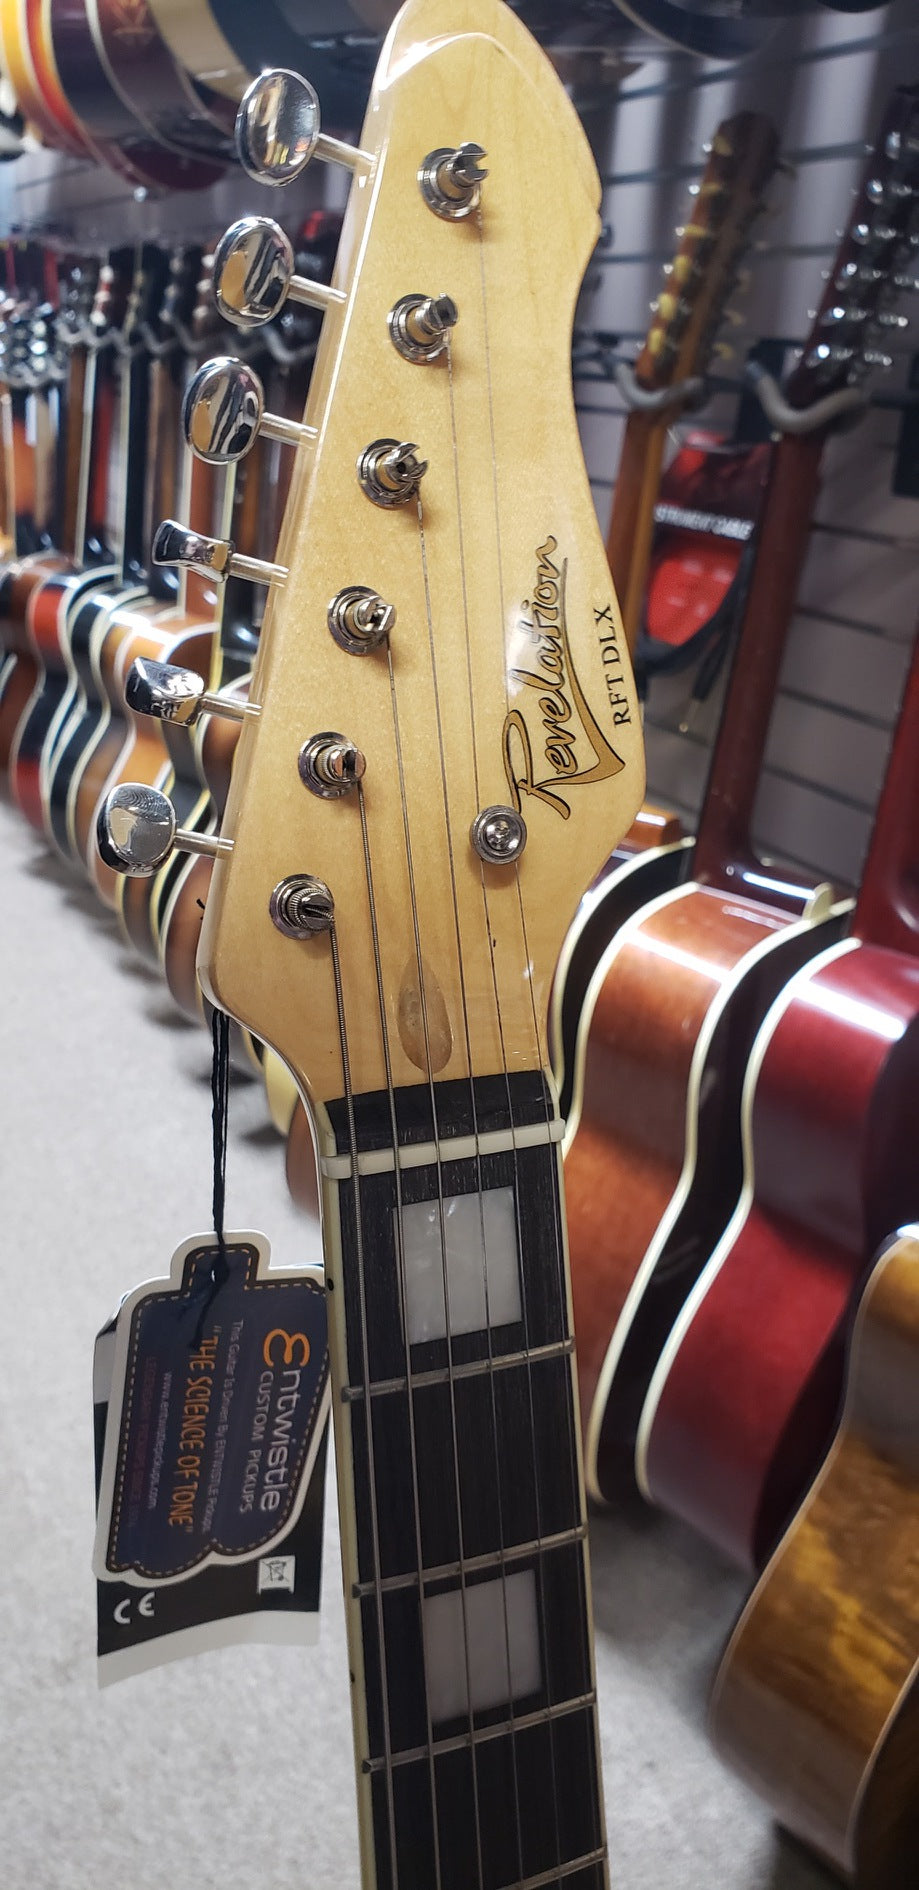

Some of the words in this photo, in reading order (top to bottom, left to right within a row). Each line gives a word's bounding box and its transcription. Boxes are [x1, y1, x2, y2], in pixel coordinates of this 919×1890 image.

[593, 603, 622, 665] DLX
[502, 535, 590, 820] Revelation
[605, 674, 632, 728] RFT
[230, 1319, 244, 1342] This
[226, 1344, 240, 1375] Guitar
[179, 1376, 214, 1451] SCIENCE
[215, 1424, 229, 1437] By
[219, 1391, 233, 1423] Driven
[250, 1370, 274, 1440] CUSTOM
[260, 1328, 310, 1512] Entwistle
[147, 1371, 174, 1509] www.entwistlepickups.com
[173, 1455, 202, 1479] OF
[209, 1439, 227, 1496] ENTWISTLE
[239, 1449, 261, 1514] PICKUPS
[113, 1590, 155, 1625] CE
